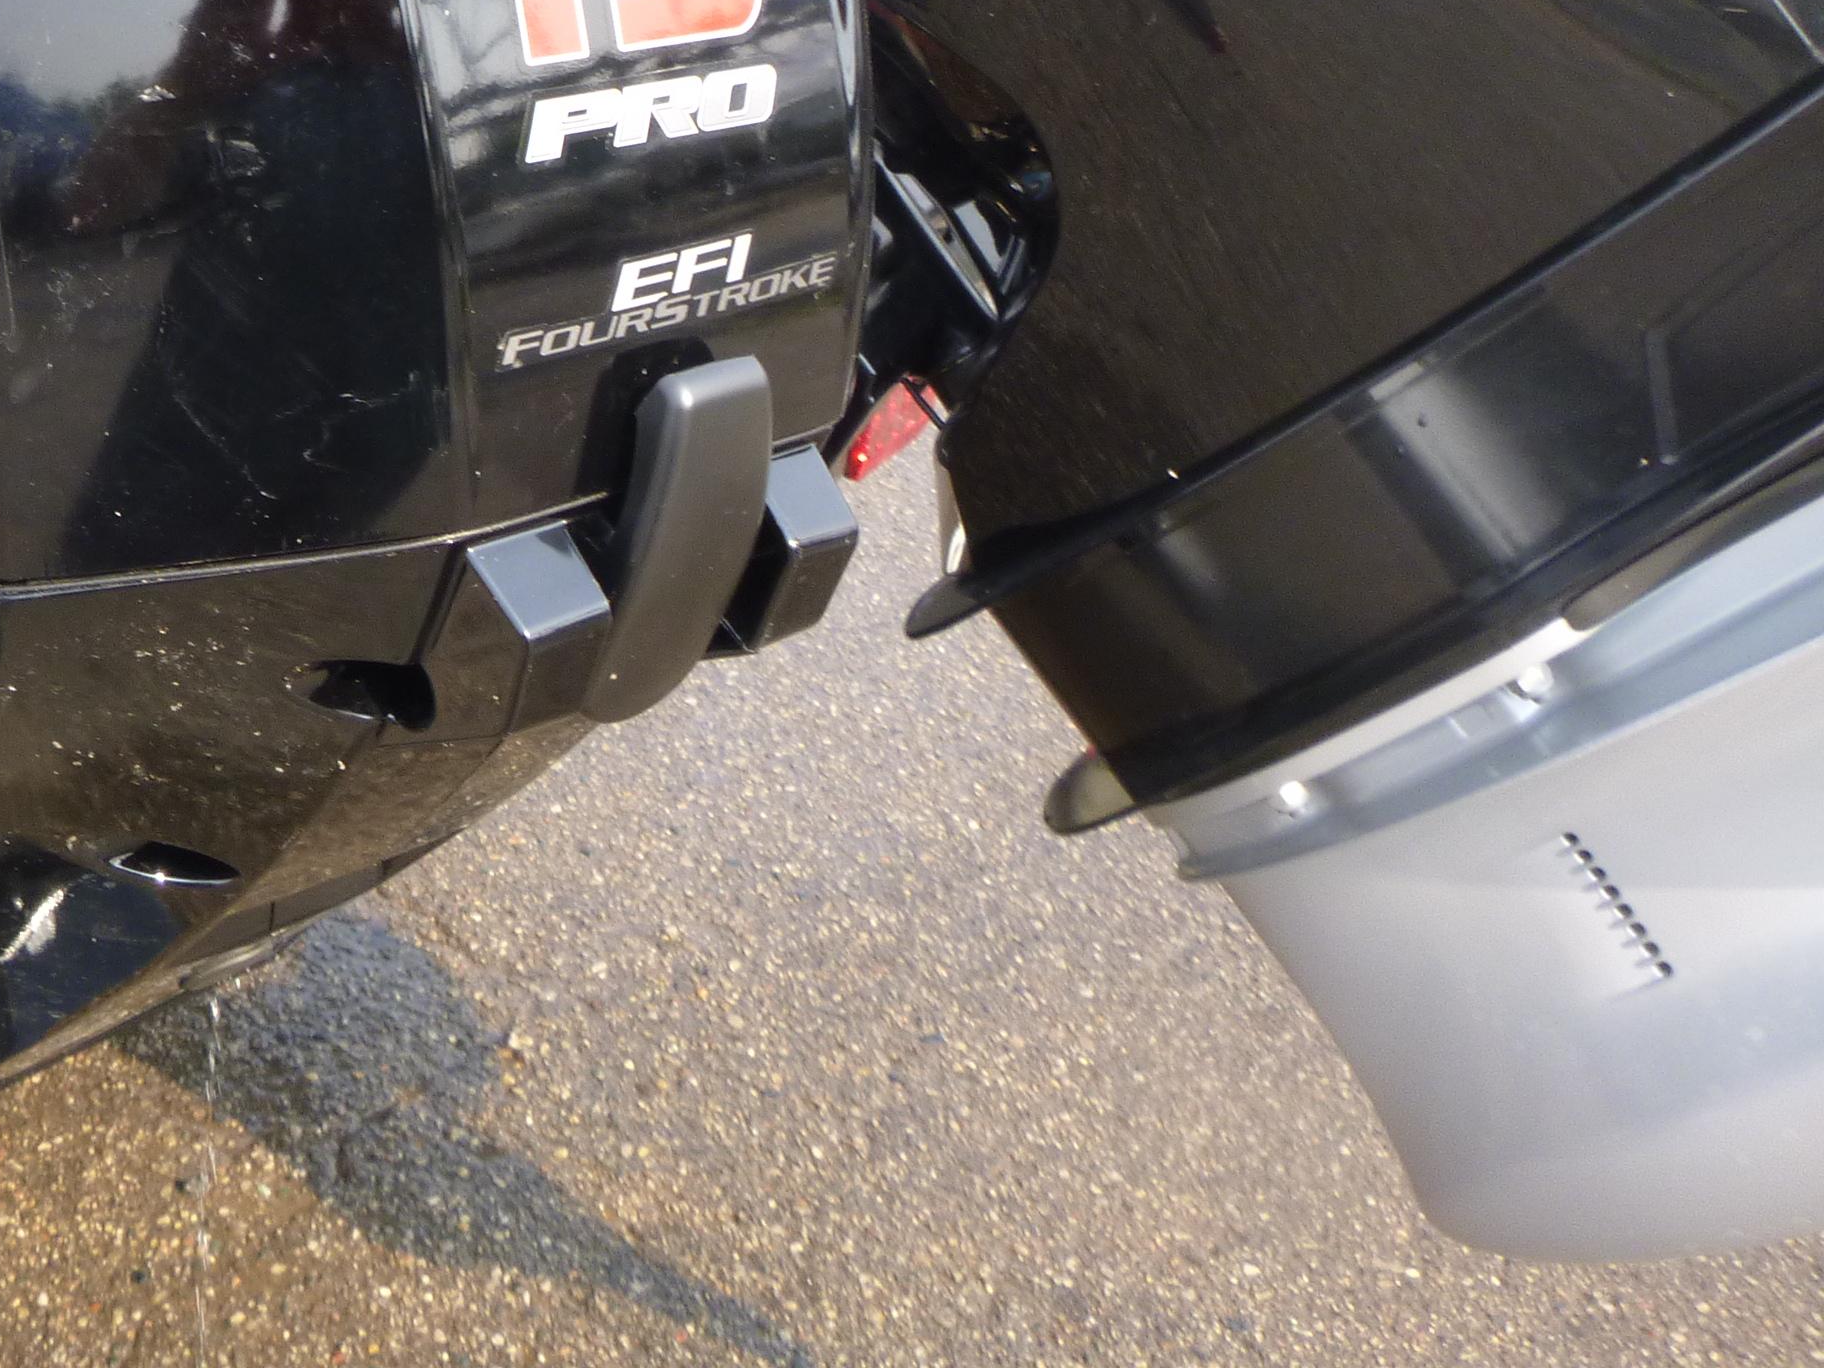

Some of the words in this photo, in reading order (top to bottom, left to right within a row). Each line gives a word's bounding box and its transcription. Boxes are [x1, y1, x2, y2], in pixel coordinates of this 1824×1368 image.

[524, 63, 777, 164] PRO
[500, 256, 836, 368] FOURSTROKE
[611, 233, 753, 313] EFI
